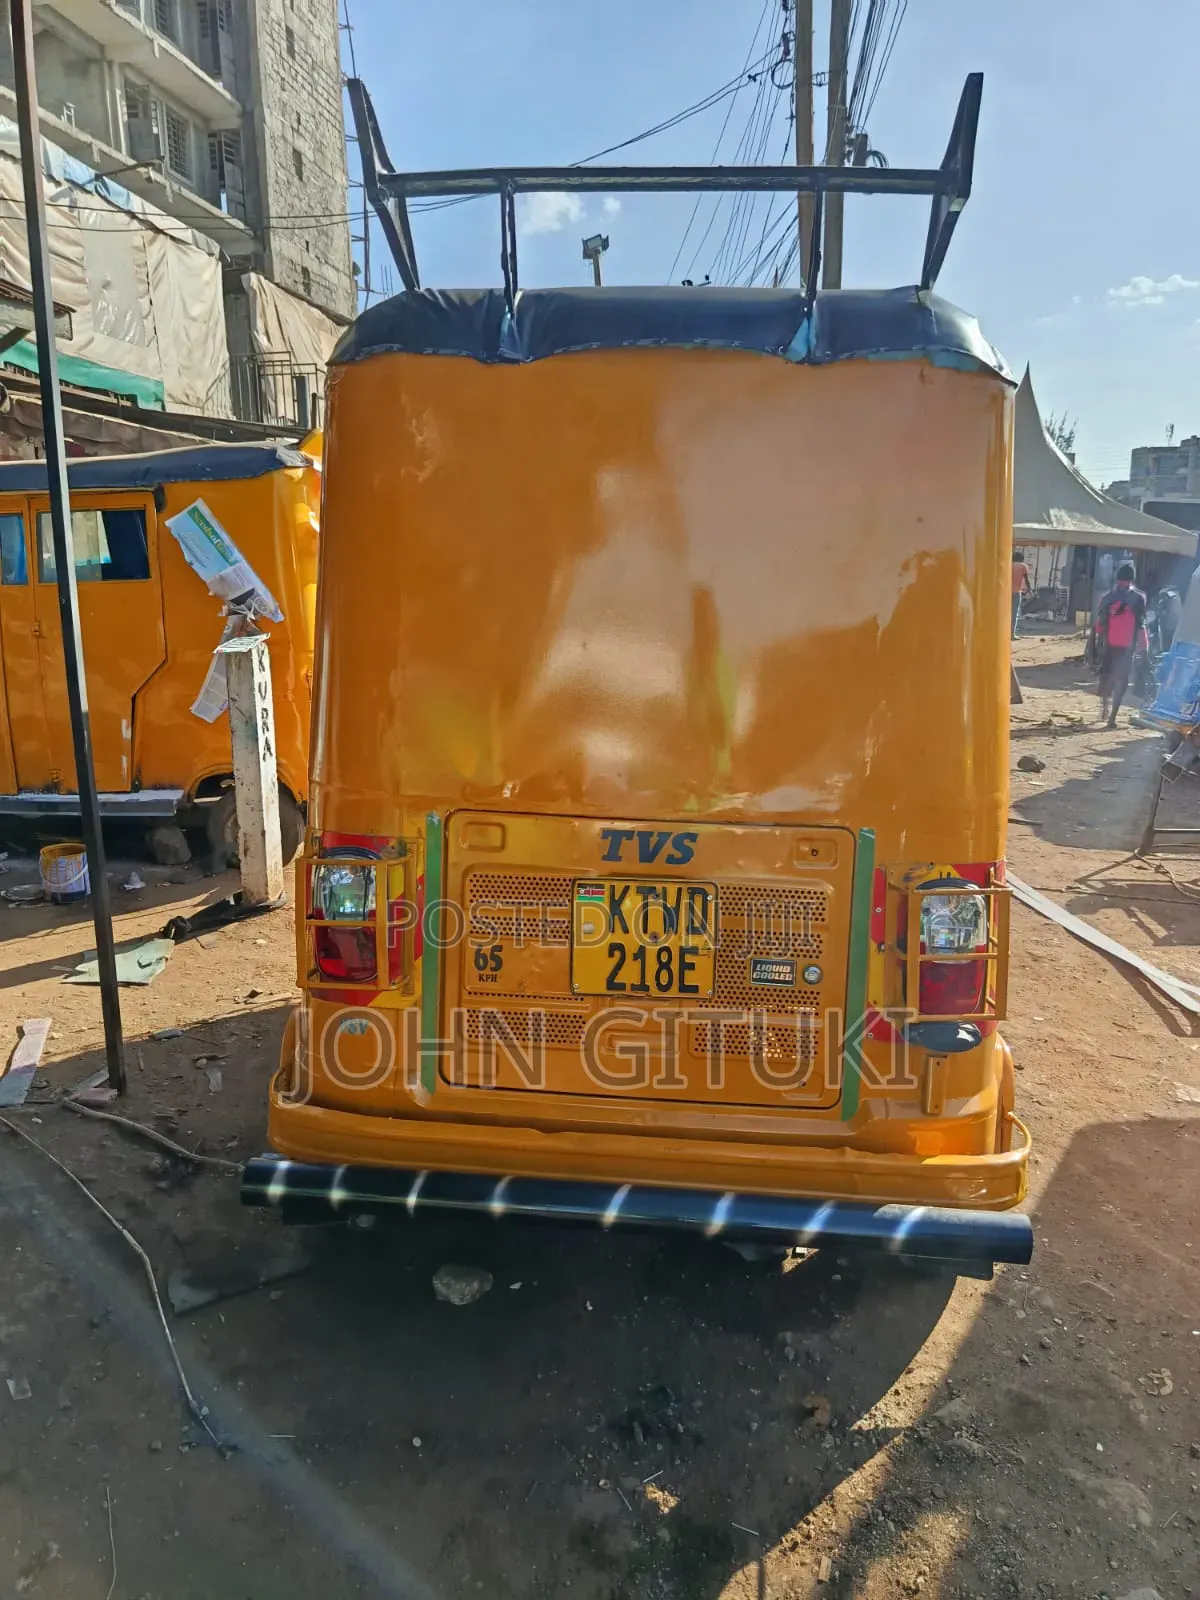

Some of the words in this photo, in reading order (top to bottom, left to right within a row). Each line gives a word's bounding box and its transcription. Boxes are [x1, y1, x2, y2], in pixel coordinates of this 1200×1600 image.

[600, 829, 698, 864] TVS
[608, 884, 708, 935] KTWD
[474, 944, 504, 972] 65
[606, 942, 699, 993] 218E
[755, 963, 791, 973] LIQUID
[478, 973, 498, 983] KPH
[752, 971, 793, 981] COOLED
